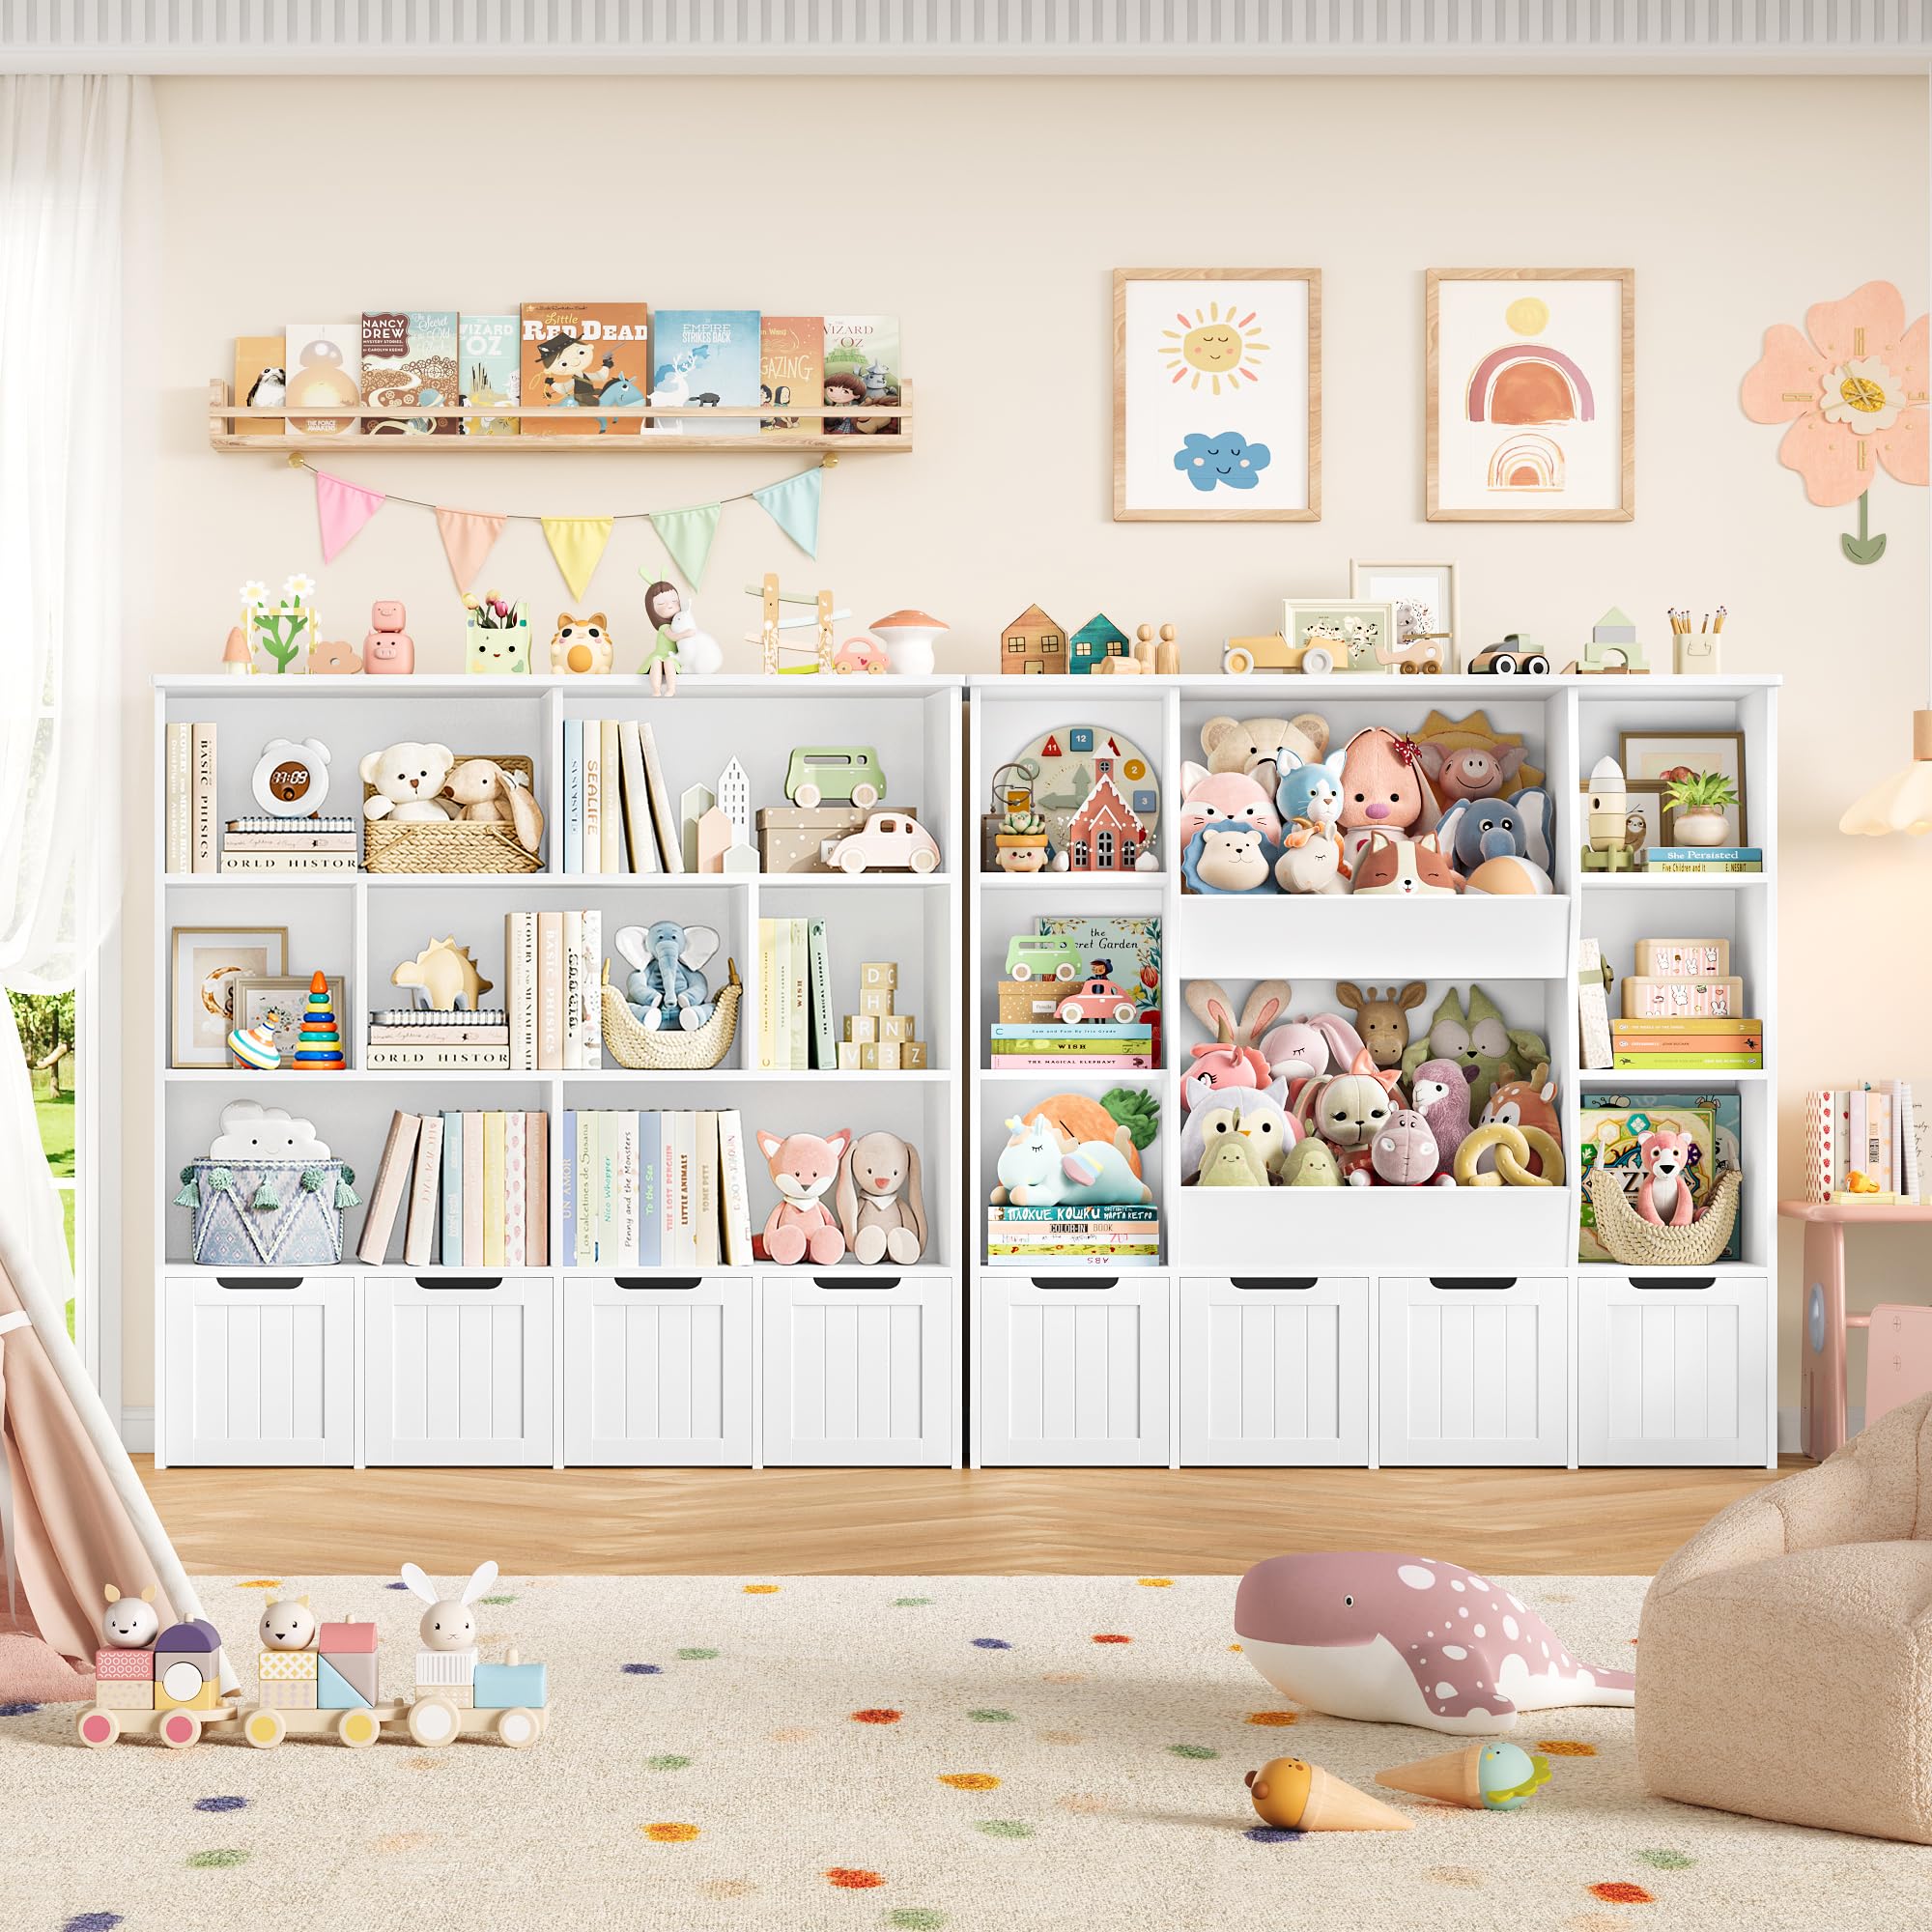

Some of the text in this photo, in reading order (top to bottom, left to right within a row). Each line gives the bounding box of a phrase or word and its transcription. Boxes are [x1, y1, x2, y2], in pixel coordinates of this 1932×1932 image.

[362, 319, 404, 328] NANCY
[545, 311, 579, 325] Little
[362, 328, 404, 339] DREW
[581, 320, 647, 341] DEAD
[683, 324, 731, 332] EMPIRE
[682, 331, 732, 343] STRIKES BACK
[466, 335, 503, 355] OZ
[200, 740, 209, 859] BASIC PHISICS
[587, 759, 598, 835] SEALIFE
[1688, 850, 1739, 859] Persisted
[222, 859, 275, 868] ORLD
[1662, 863, 1671, 872] Five
[1672, 863, 1691, 872] Children
[1692, 863, 1701, 872] and
[1730, 863, 1747, 872] NESBIT
[1091, 928, 1106, 937] the
[1098, 937, 1138, 950] Garden
[546, 929, 555, 979] BASIC
[867, 968, 880, 983] D
[888, 968, 895, 984] C
[867, 994, 879, 1009] H
[846, 1019, 851, 1036] S
[859, 1020, 870, 1037] R
[886, 1020, 898, 1037] N
[369, 1054, 424, 1063] ORLD
[846, 1050, 859, 1063] V
[867, 1048, 874, 1064] 4
[887, 1049, 895, 1064] 3
[911, 1048, 921, 1063] Z
[623, 1131, 632, 1176] Monsters
[604, 1155, 612, 1199] Whopper
[580, 1123, 591, 1255] Los calcetines de Susana
[645, 1164, 654, 1216] To the Sea
[563, 1200, 572, 1219] UN
[1008, 1208, 1100, 1221] ПЛОХИЕ КОШКИ
[1103, 1211, 1152, 1220] МАРТА КЕТРО
[624, 1217, 634, 1248] Penny
[1050, 1223, 1113, 1234] COLOR-IN BOOK
